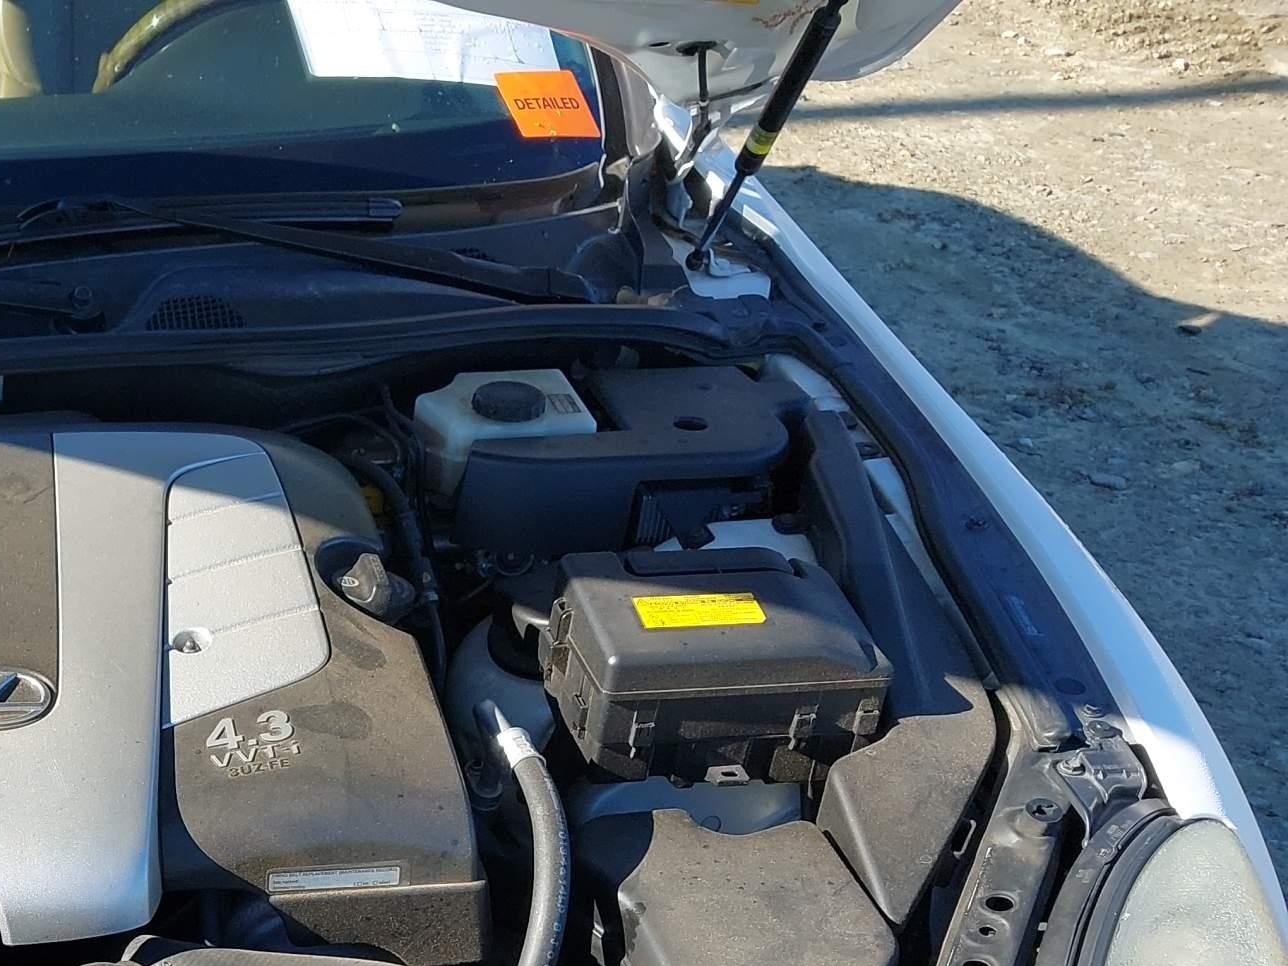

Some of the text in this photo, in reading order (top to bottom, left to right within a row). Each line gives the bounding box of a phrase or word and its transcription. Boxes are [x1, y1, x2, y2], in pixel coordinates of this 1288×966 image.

[513, 97, 580, 110] DETAILED
[205, 709, 297, 750] 4.3
[209, 739, 302, 768] VVT-i
[228, 758, 291, 778] 3UZ-FE
